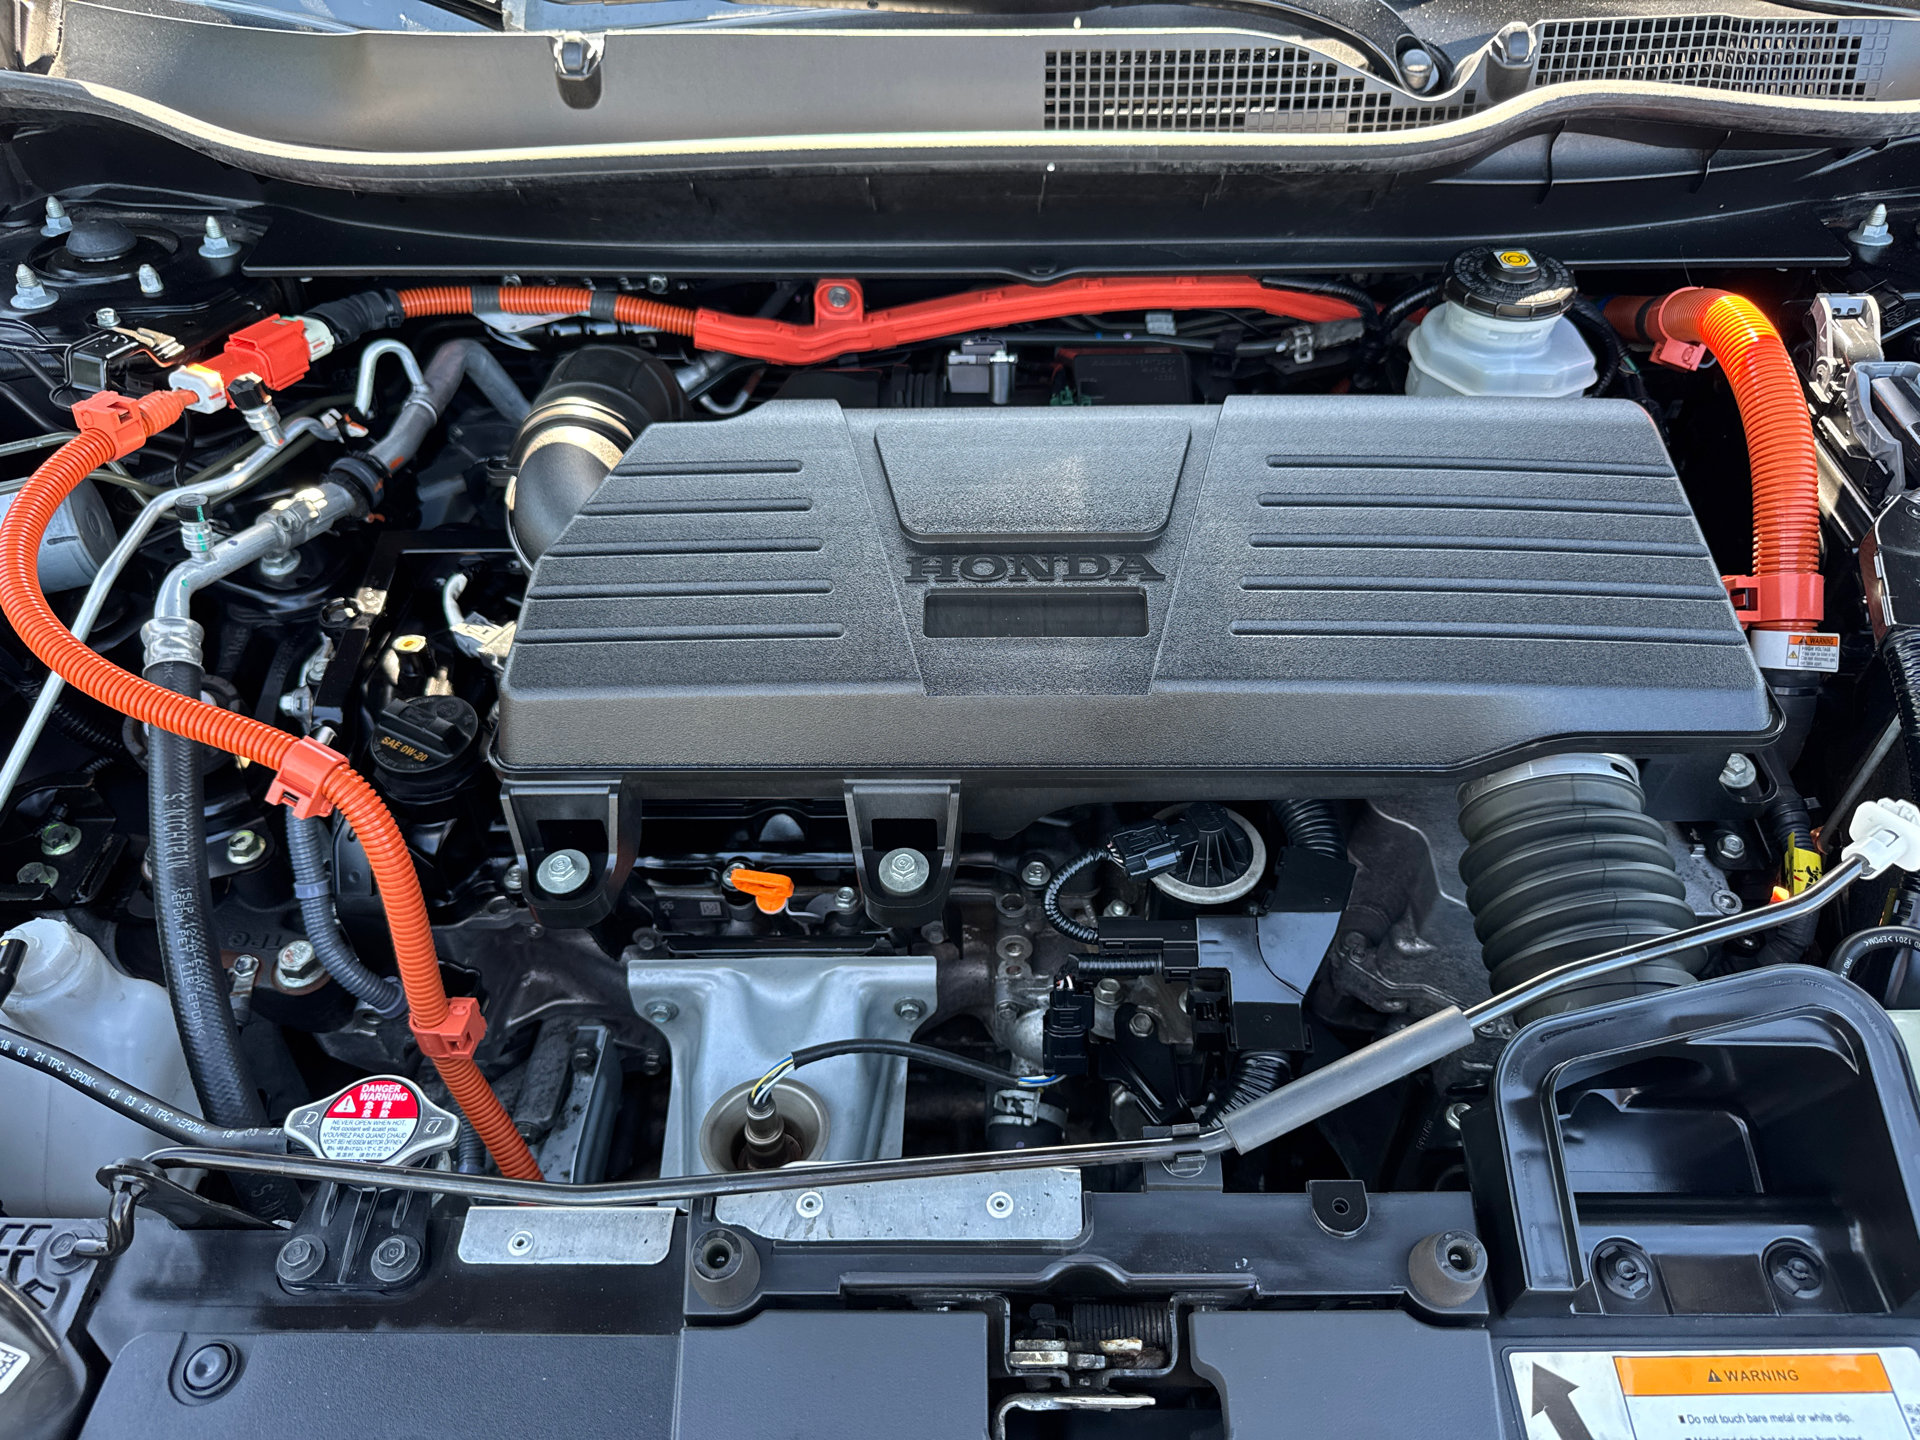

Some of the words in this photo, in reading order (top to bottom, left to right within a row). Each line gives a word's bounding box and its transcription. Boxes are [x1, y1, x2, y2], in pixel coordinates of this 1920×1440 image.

[904, 554, 1165, 583] HONDA
[381, 736, 402, 750] SAE
[17, 1046, 28, 1058] 03
[34, 1051, 46, 1063] 21
[47, 1056, 65, 1072] TPC
[107, 1088, 120, 1100] 18
[124, 1095, 137, 1107] 03
[140, 1102, 153, 1114] 21
[154, 1108, 174, 1122] TPC
[361, 1084, 401, 1093] DANGER
[359, 1093, 408, 1101] WARNUNG
[1724, 1369, 1800, 1382] WARNING
[1687, 1414, 1701, 1424] Do
[1703, 1414, 1718, 1424] not
[1719, 1413, 1745, 1423] touch
[1746, 1413, 1768, 1423] bare
[1769, 1413, 1795, 1423] metal
[1797, 1414, 1806, 1423] or
[1808, 1413, 1832, 1423] white
